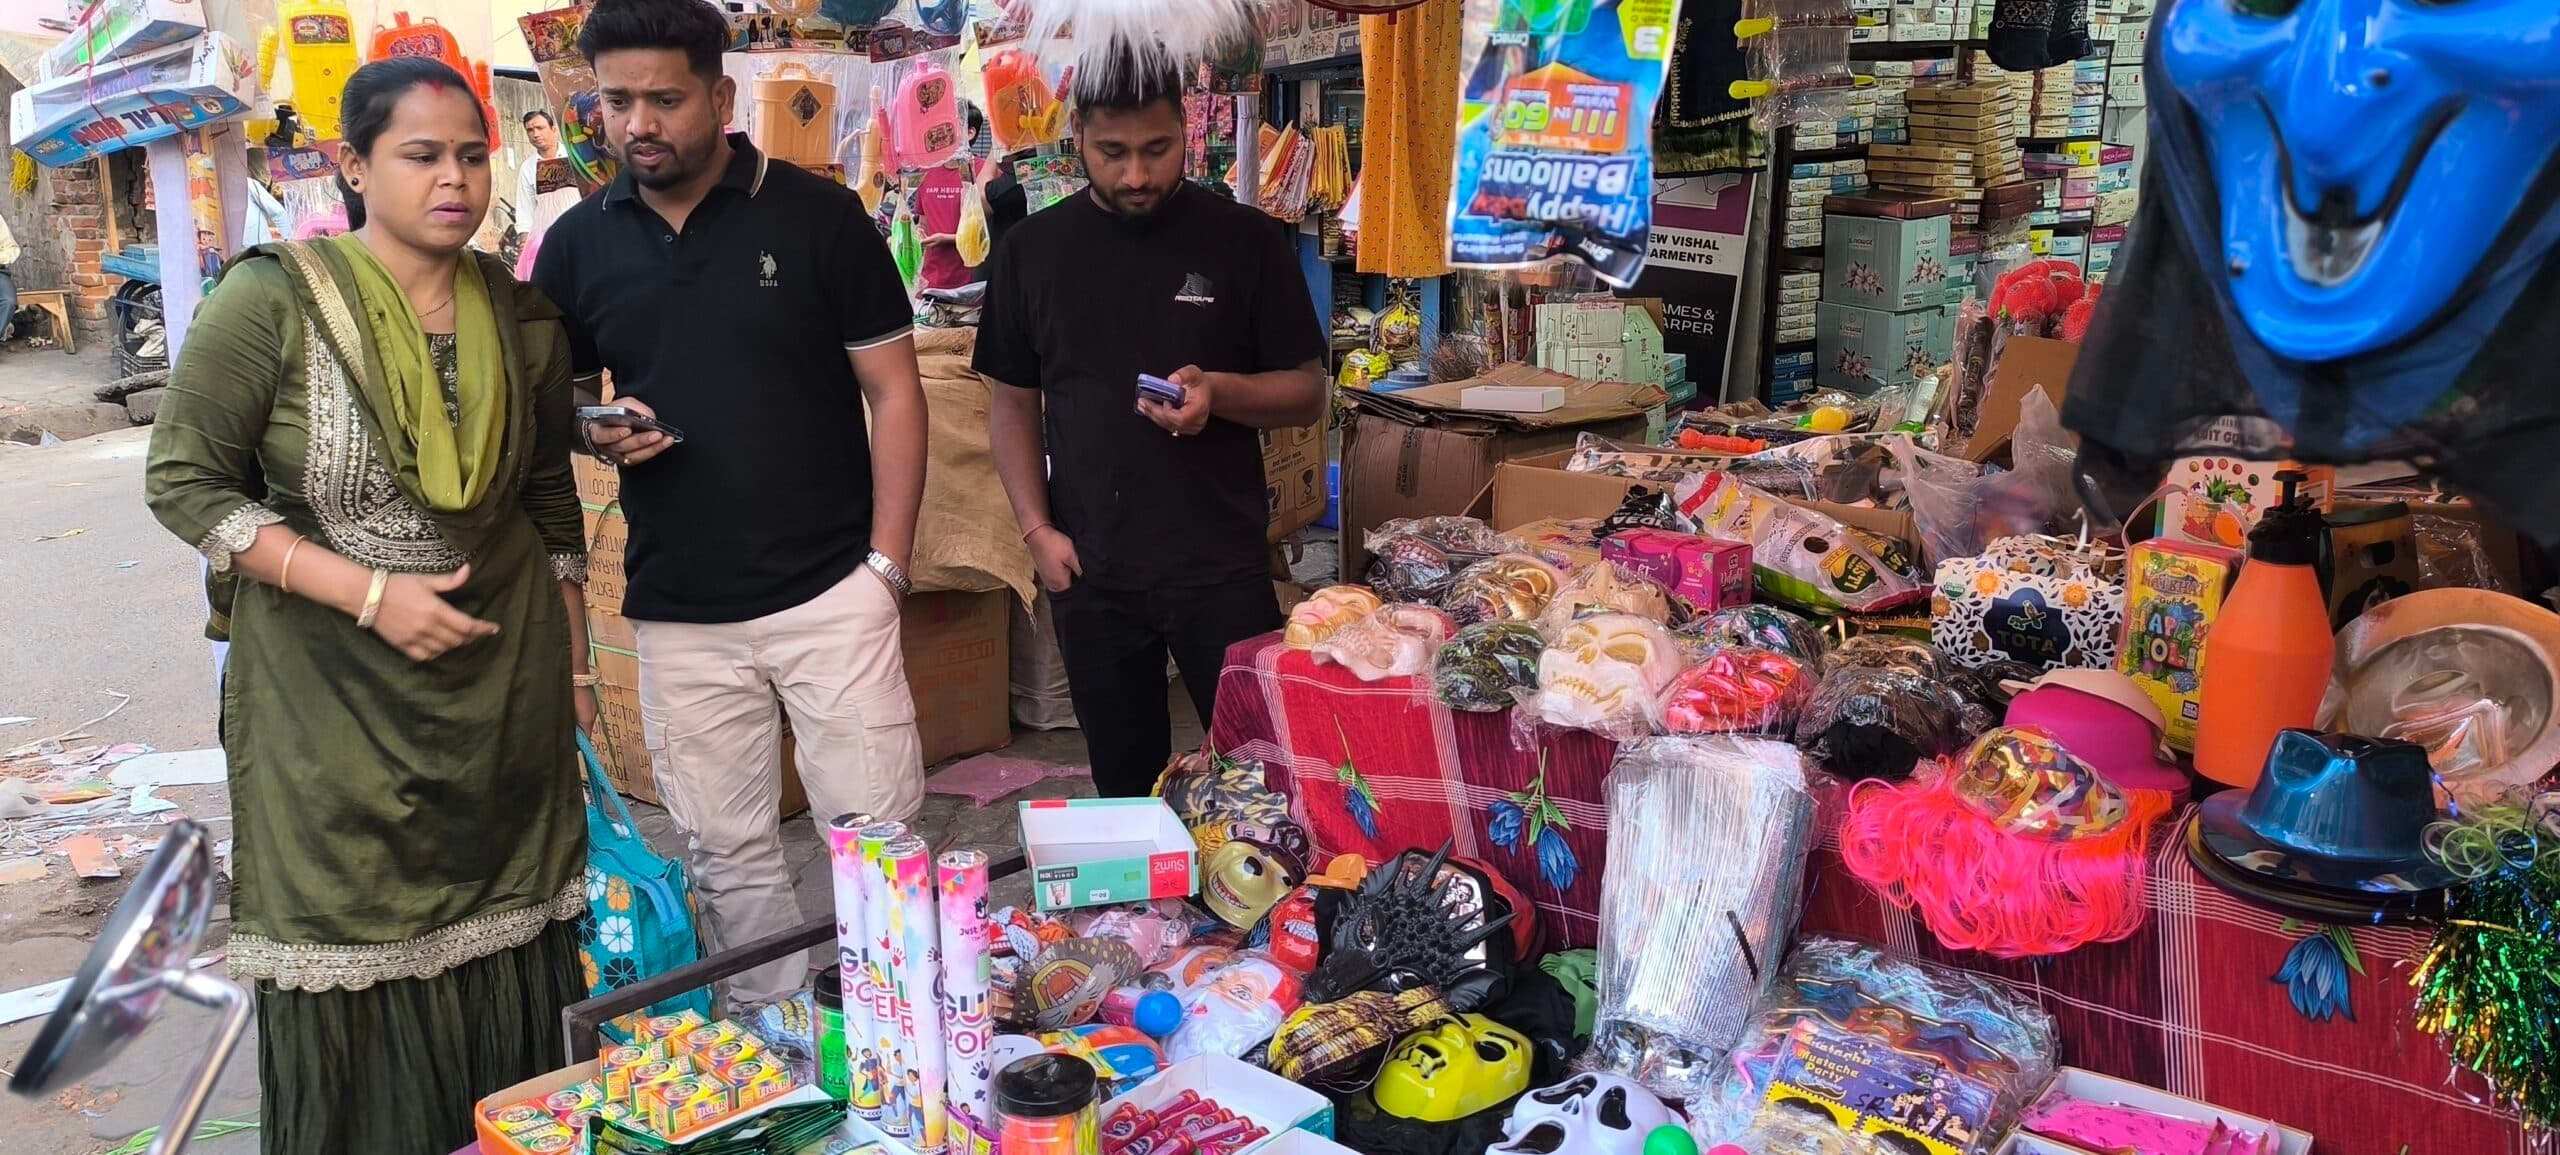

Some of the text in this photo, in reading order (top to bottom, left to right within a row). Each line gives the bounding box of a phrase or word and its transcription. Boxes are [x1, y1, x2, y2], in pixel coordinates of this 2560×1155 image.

[70, 116, 128, 147] GUN
[1483, 158, 1629, 195] Balloons
[1525, 190, 1627, 233] Happy
[1649, 233, 1719, 250] EW VISHAL
[1647, 249, 1713, 265] ARMENTS
[1662, 303, 1716, 321] AMES &
[1663, 318, 1713, 335] ARPER
[2130, 608, 2210, 644] HAPPY
[1996, 629, 2057, 655] TOTA
[2130, 634, 2198, 670] HOLI
[1153, 858, 1185, 872] Slimz
[1803, 1061, 1844, 1084] Party
[695, 1100, 726, 1119] TIGER
